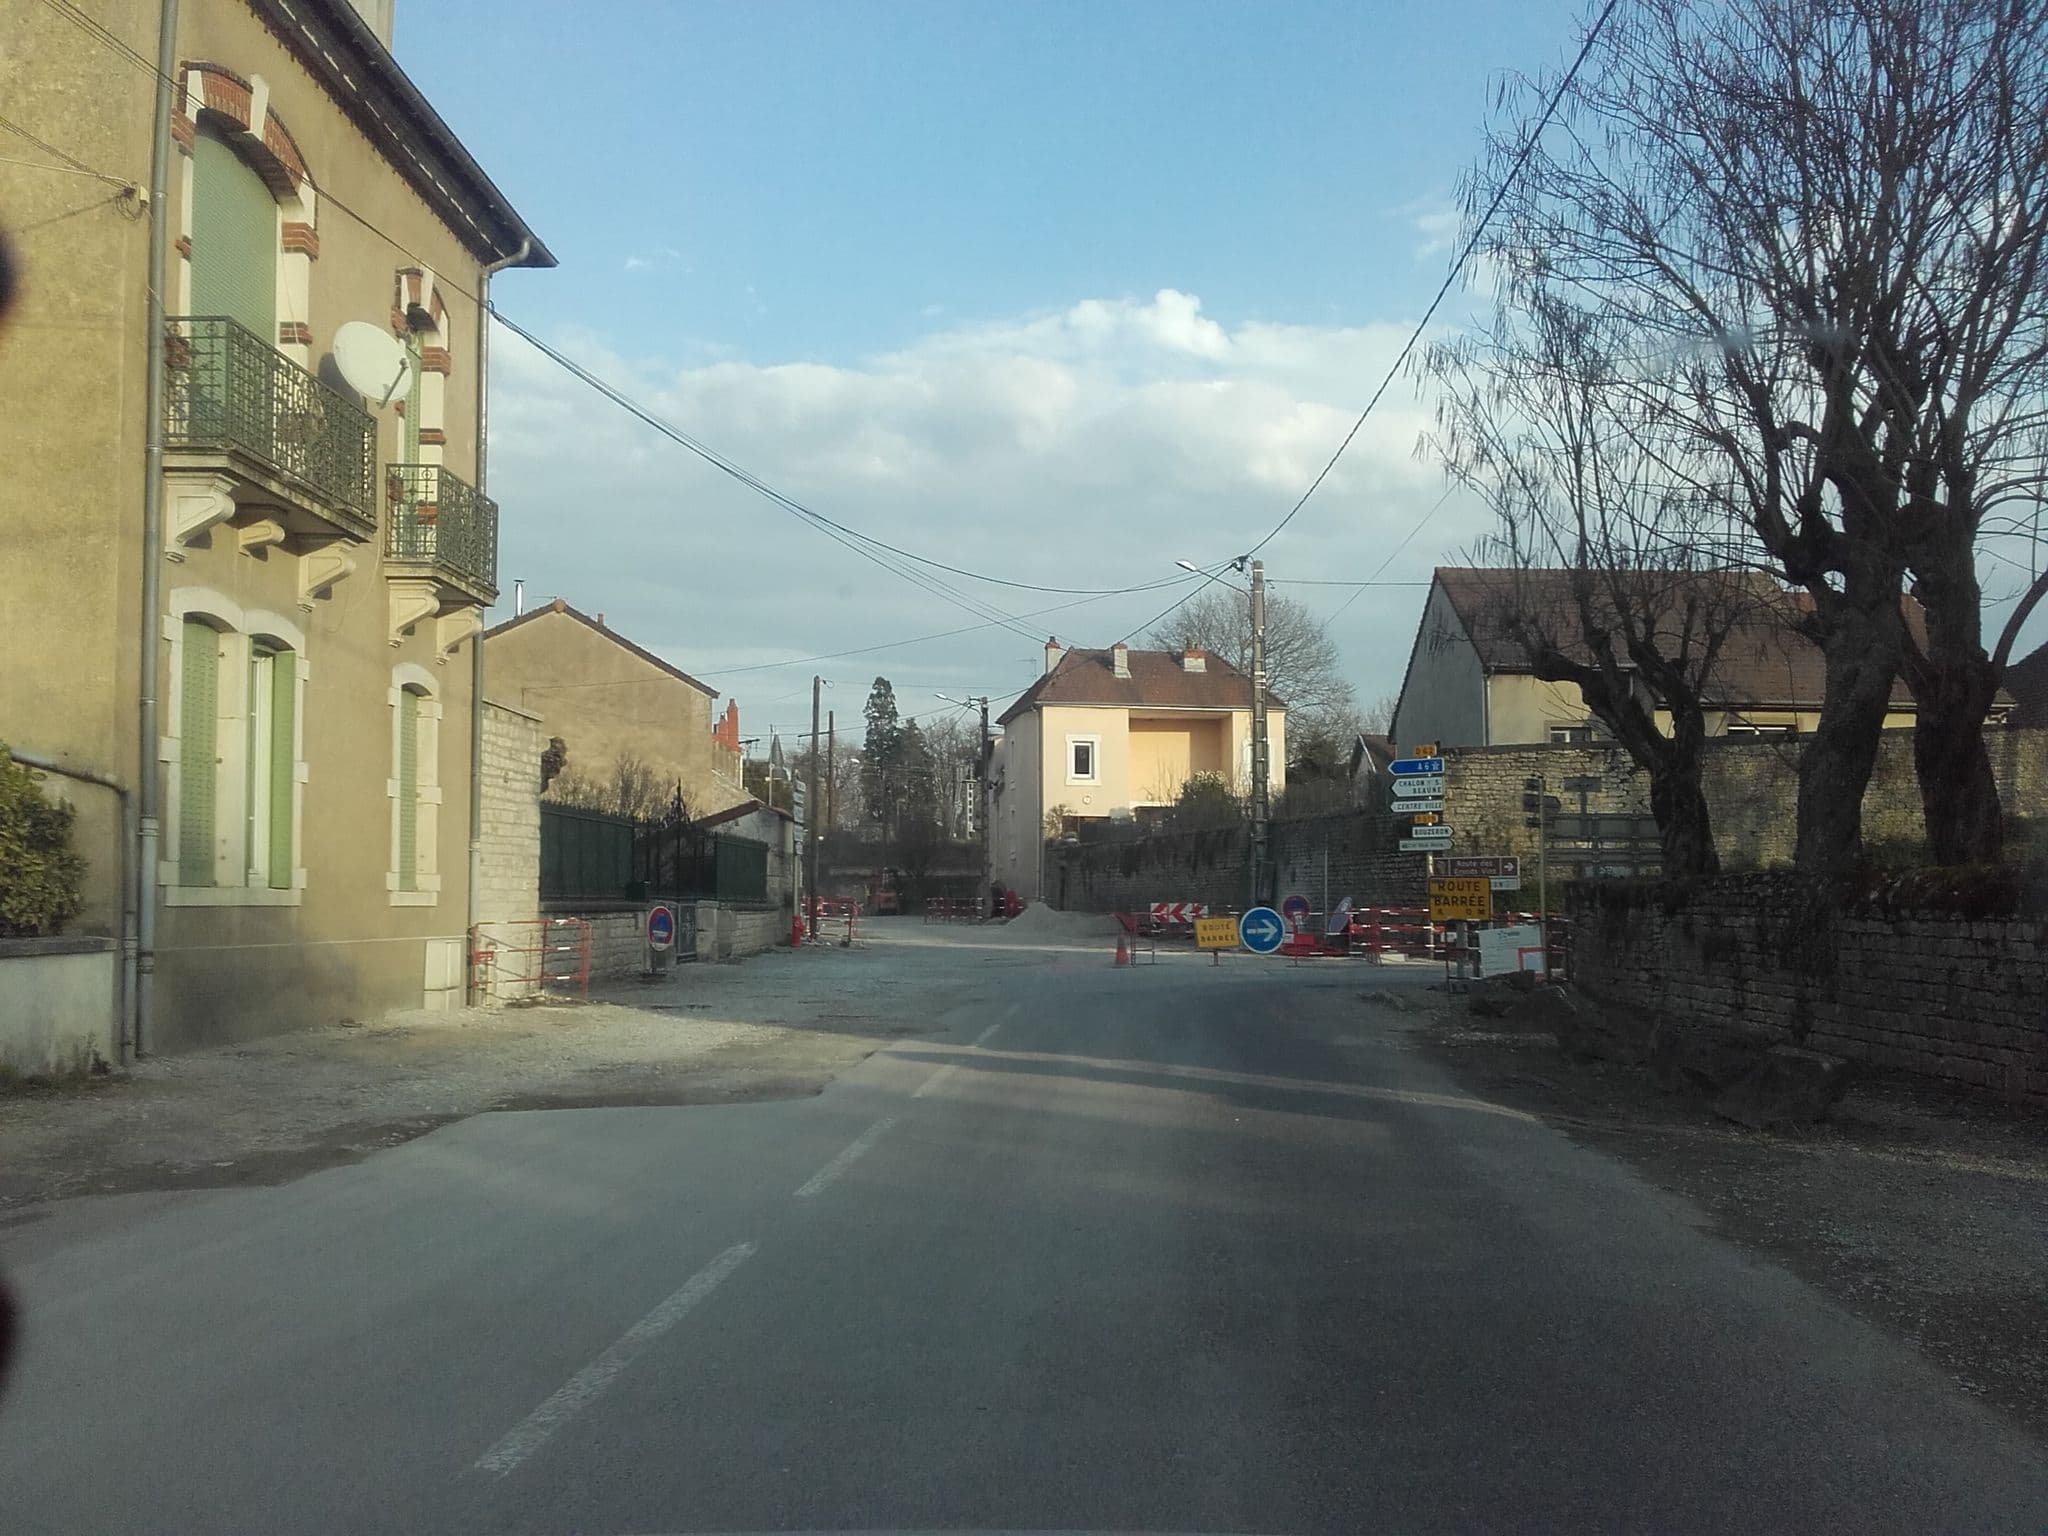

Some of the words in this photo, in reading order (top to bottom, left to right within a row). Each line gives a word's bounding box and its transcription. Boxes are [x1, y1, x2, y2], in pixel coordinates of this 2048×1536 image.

[1413, 786, 1441, 794] BEAUNE
[1397, 802, 1421, 810] CENTRE
[1425, 801, 1442, 809] VILLE
[1414, 828, 1449, 836] BOUZERON
[1438, 880, 1480, 892] ROUTE
[1434, 893, 1485, 907] BARRÉE
[1202, 923, 1231, 931] ROUTE
[1200, 934, 1235, 942] BARRÉE
